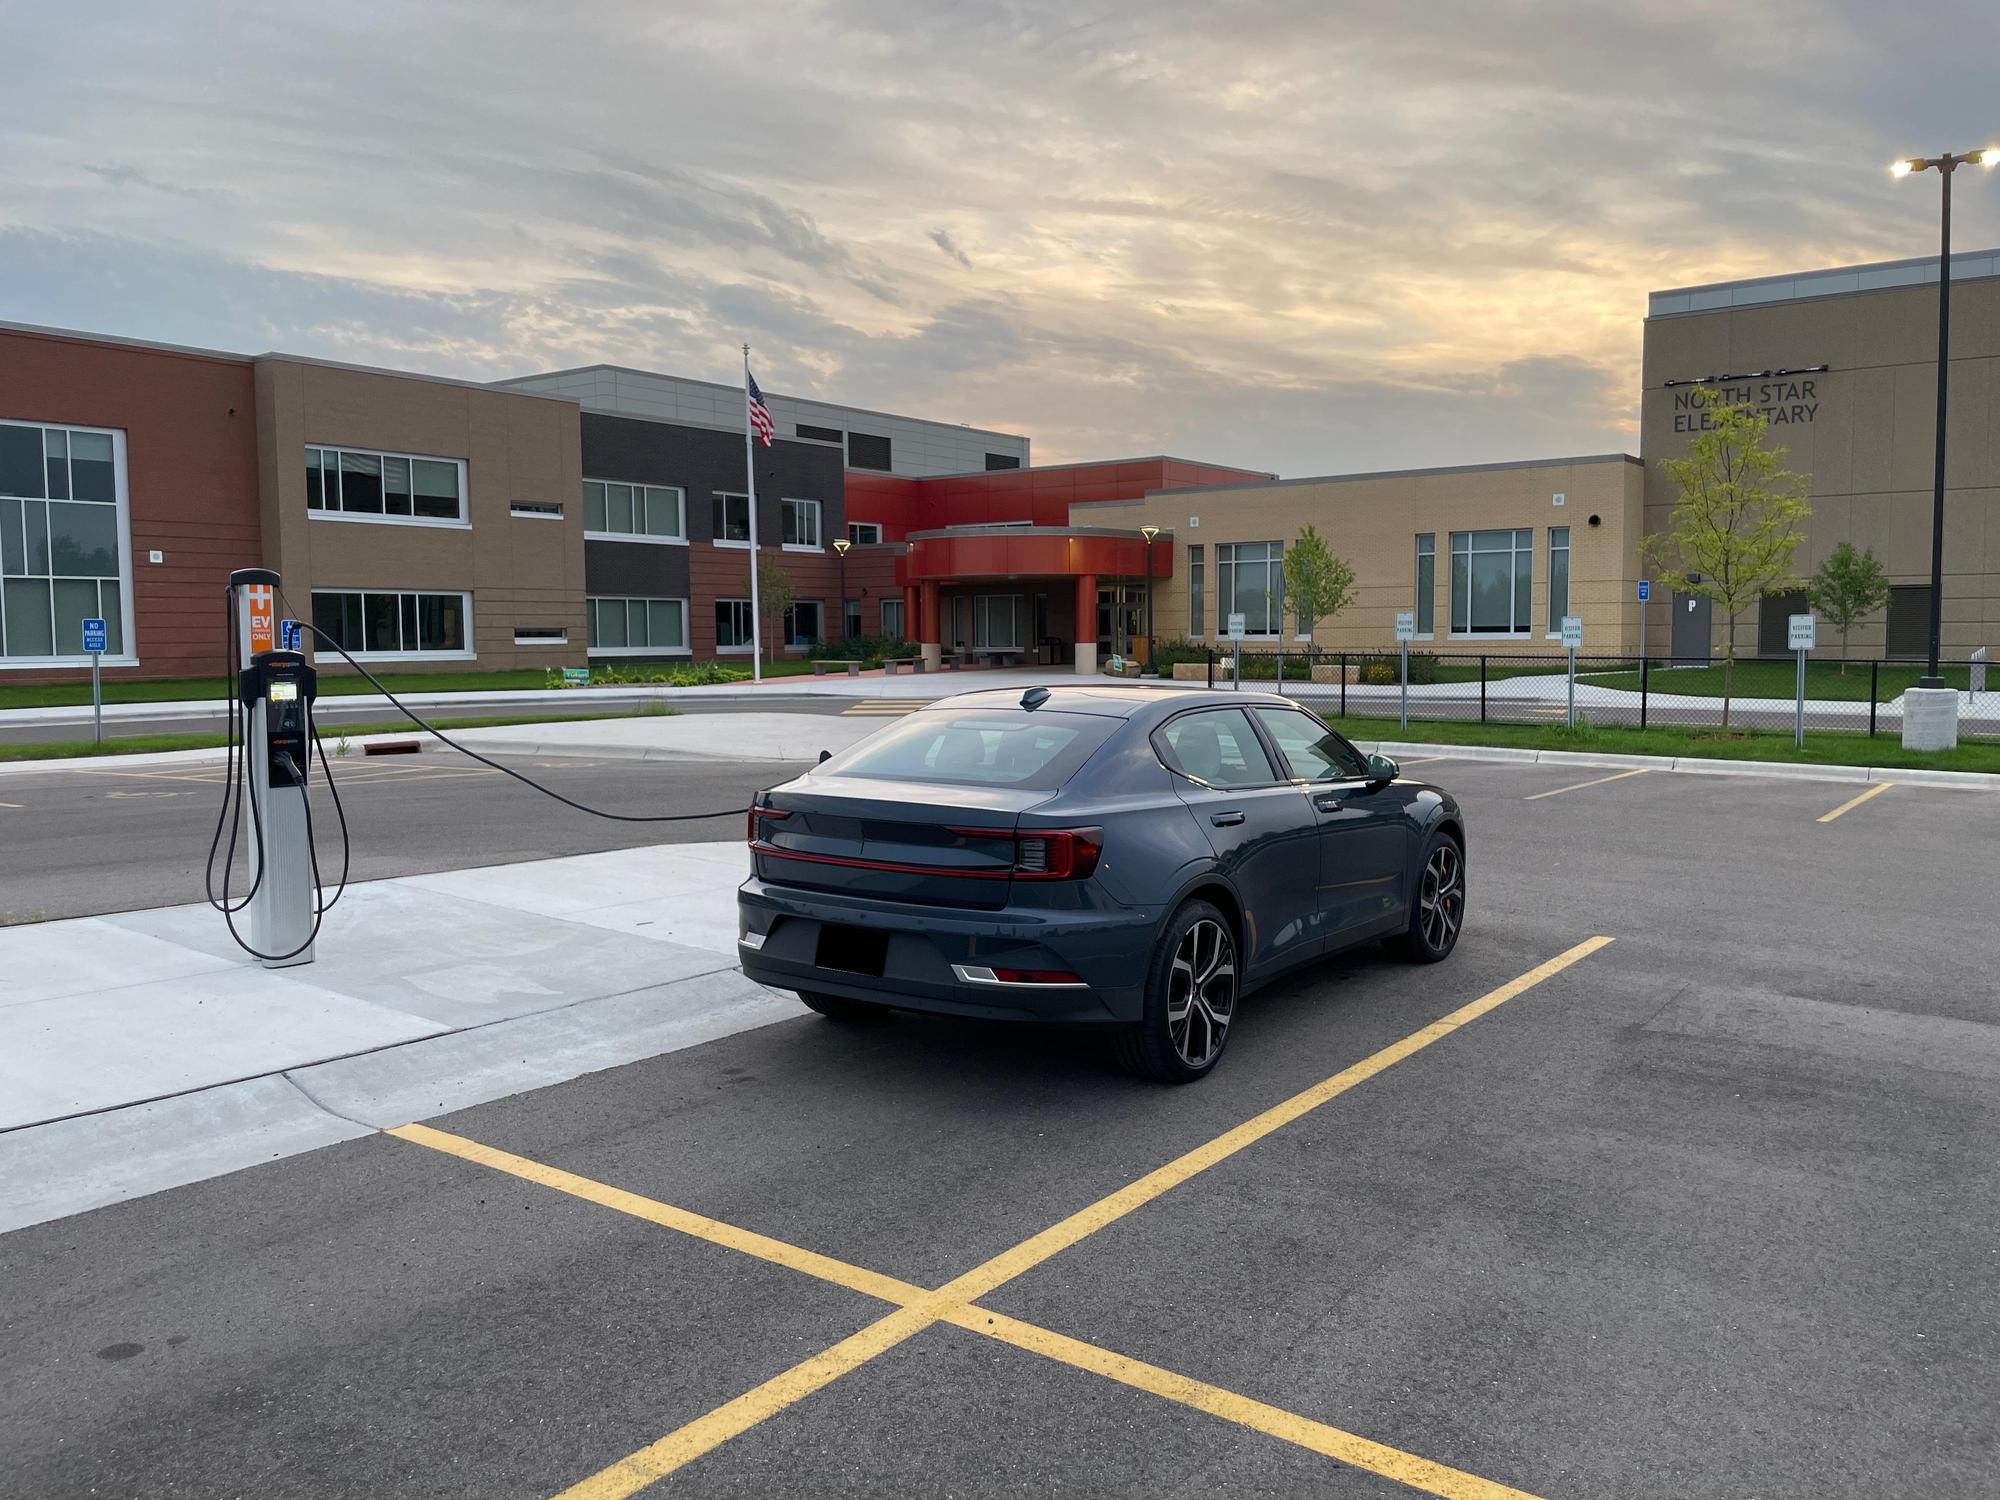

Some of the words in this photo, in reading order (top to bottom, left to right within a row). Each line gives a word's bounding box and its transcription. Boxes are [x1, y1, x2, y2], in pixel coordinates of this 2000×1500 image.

[1760, 381, 1817, 403] STAR
[1674, 403, 1819, 433] ELEENTARY
[90, 622, 99, 630] NO
[252, 616, 270, 628] EV
